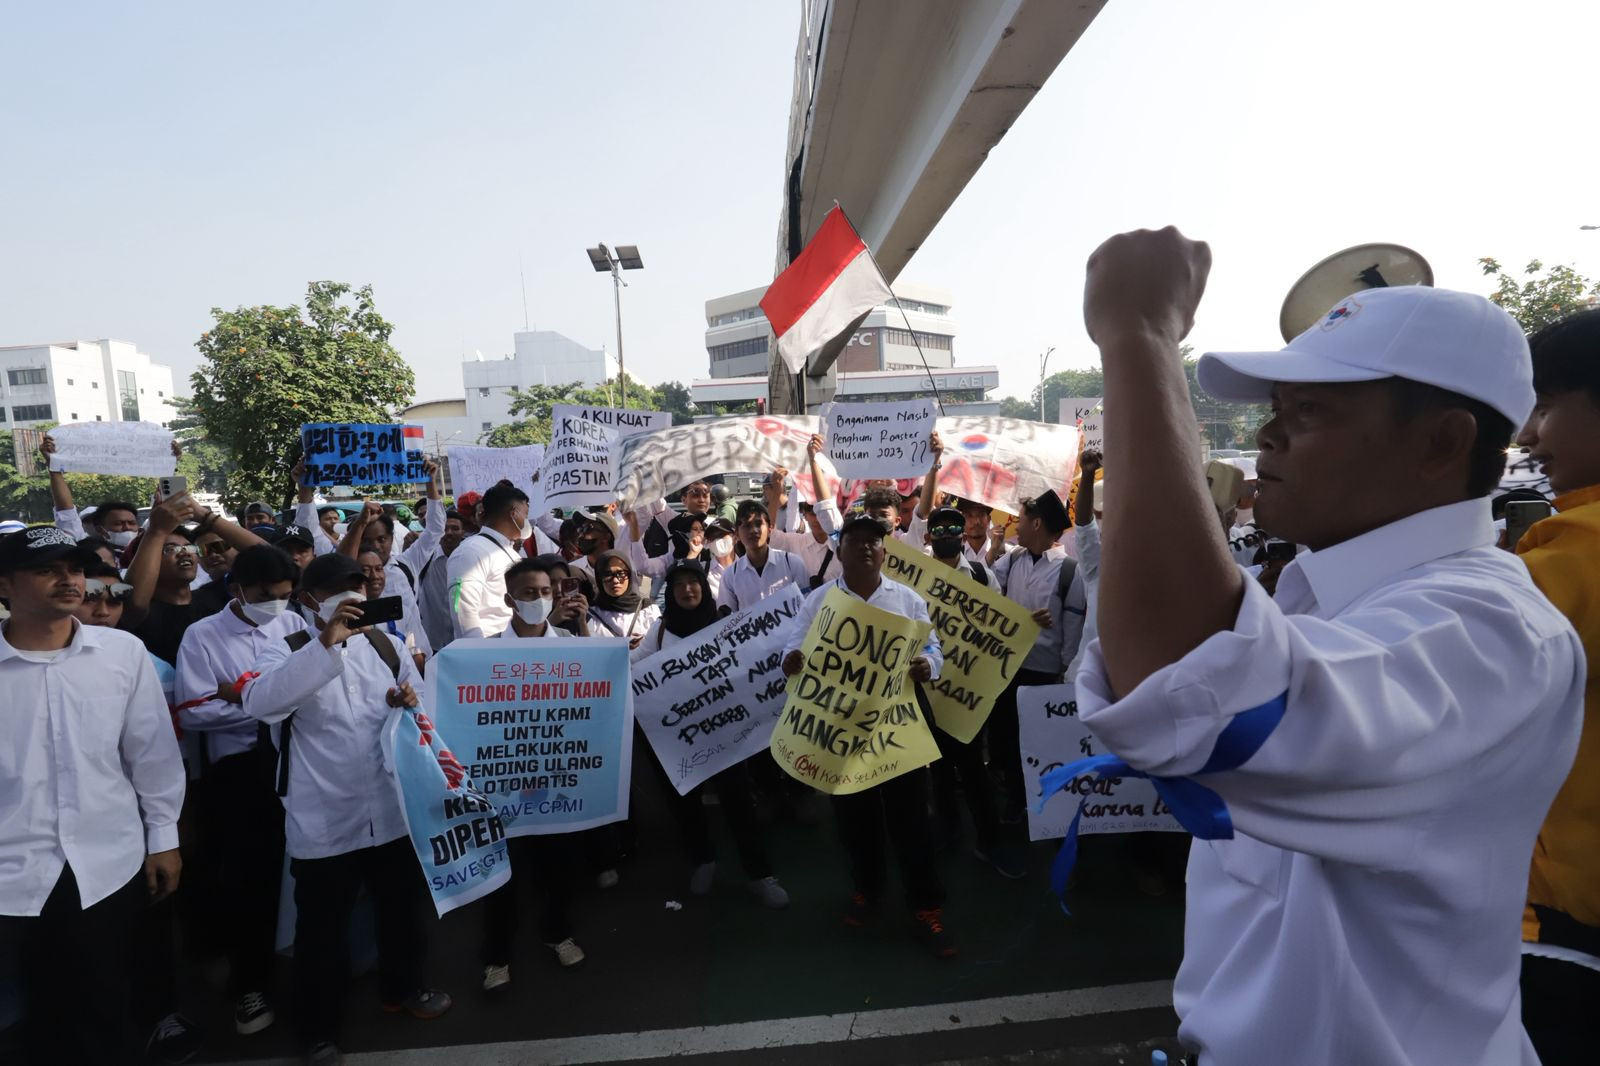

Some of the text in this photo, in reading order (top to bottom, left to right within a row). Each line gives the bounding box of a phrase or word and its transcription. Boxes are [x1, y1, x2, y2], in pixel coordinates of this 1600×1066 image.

[847, 333, 873, 346] FC
[617, 411, 652, 428] KUAT
[897, 408, 929, 421] Nasib
[563, 418, 608, 443] KOREA
[557, 437, 609, 454] PERHATIAN
[877, 447, 904, 459] 2023
[567, 452, 608, 465] BUTUH
[927, 577, 1020, 637] BERSATU
[490, 662, 582, 680] 도와주세요
[632, 672, 658, 696] INI
[661, 638, 721, 683] BUKAN
[807, 646, 878, 695] CPMI
[457, 681, 611, 704] TOLONG BANTU KAMI
[477, 706, 591, 725] BANTU KAMI
[1045, 701, 1078, 718] KOR
[504, 724, 564, 740] UNTUK
[477, 740, 587, 760] MELAKUKAN
[545, 756, 603, 771] ULANG
[484, 774, 578, 795] OTOMATIS
[539, 799, 583, 814] CPMI
